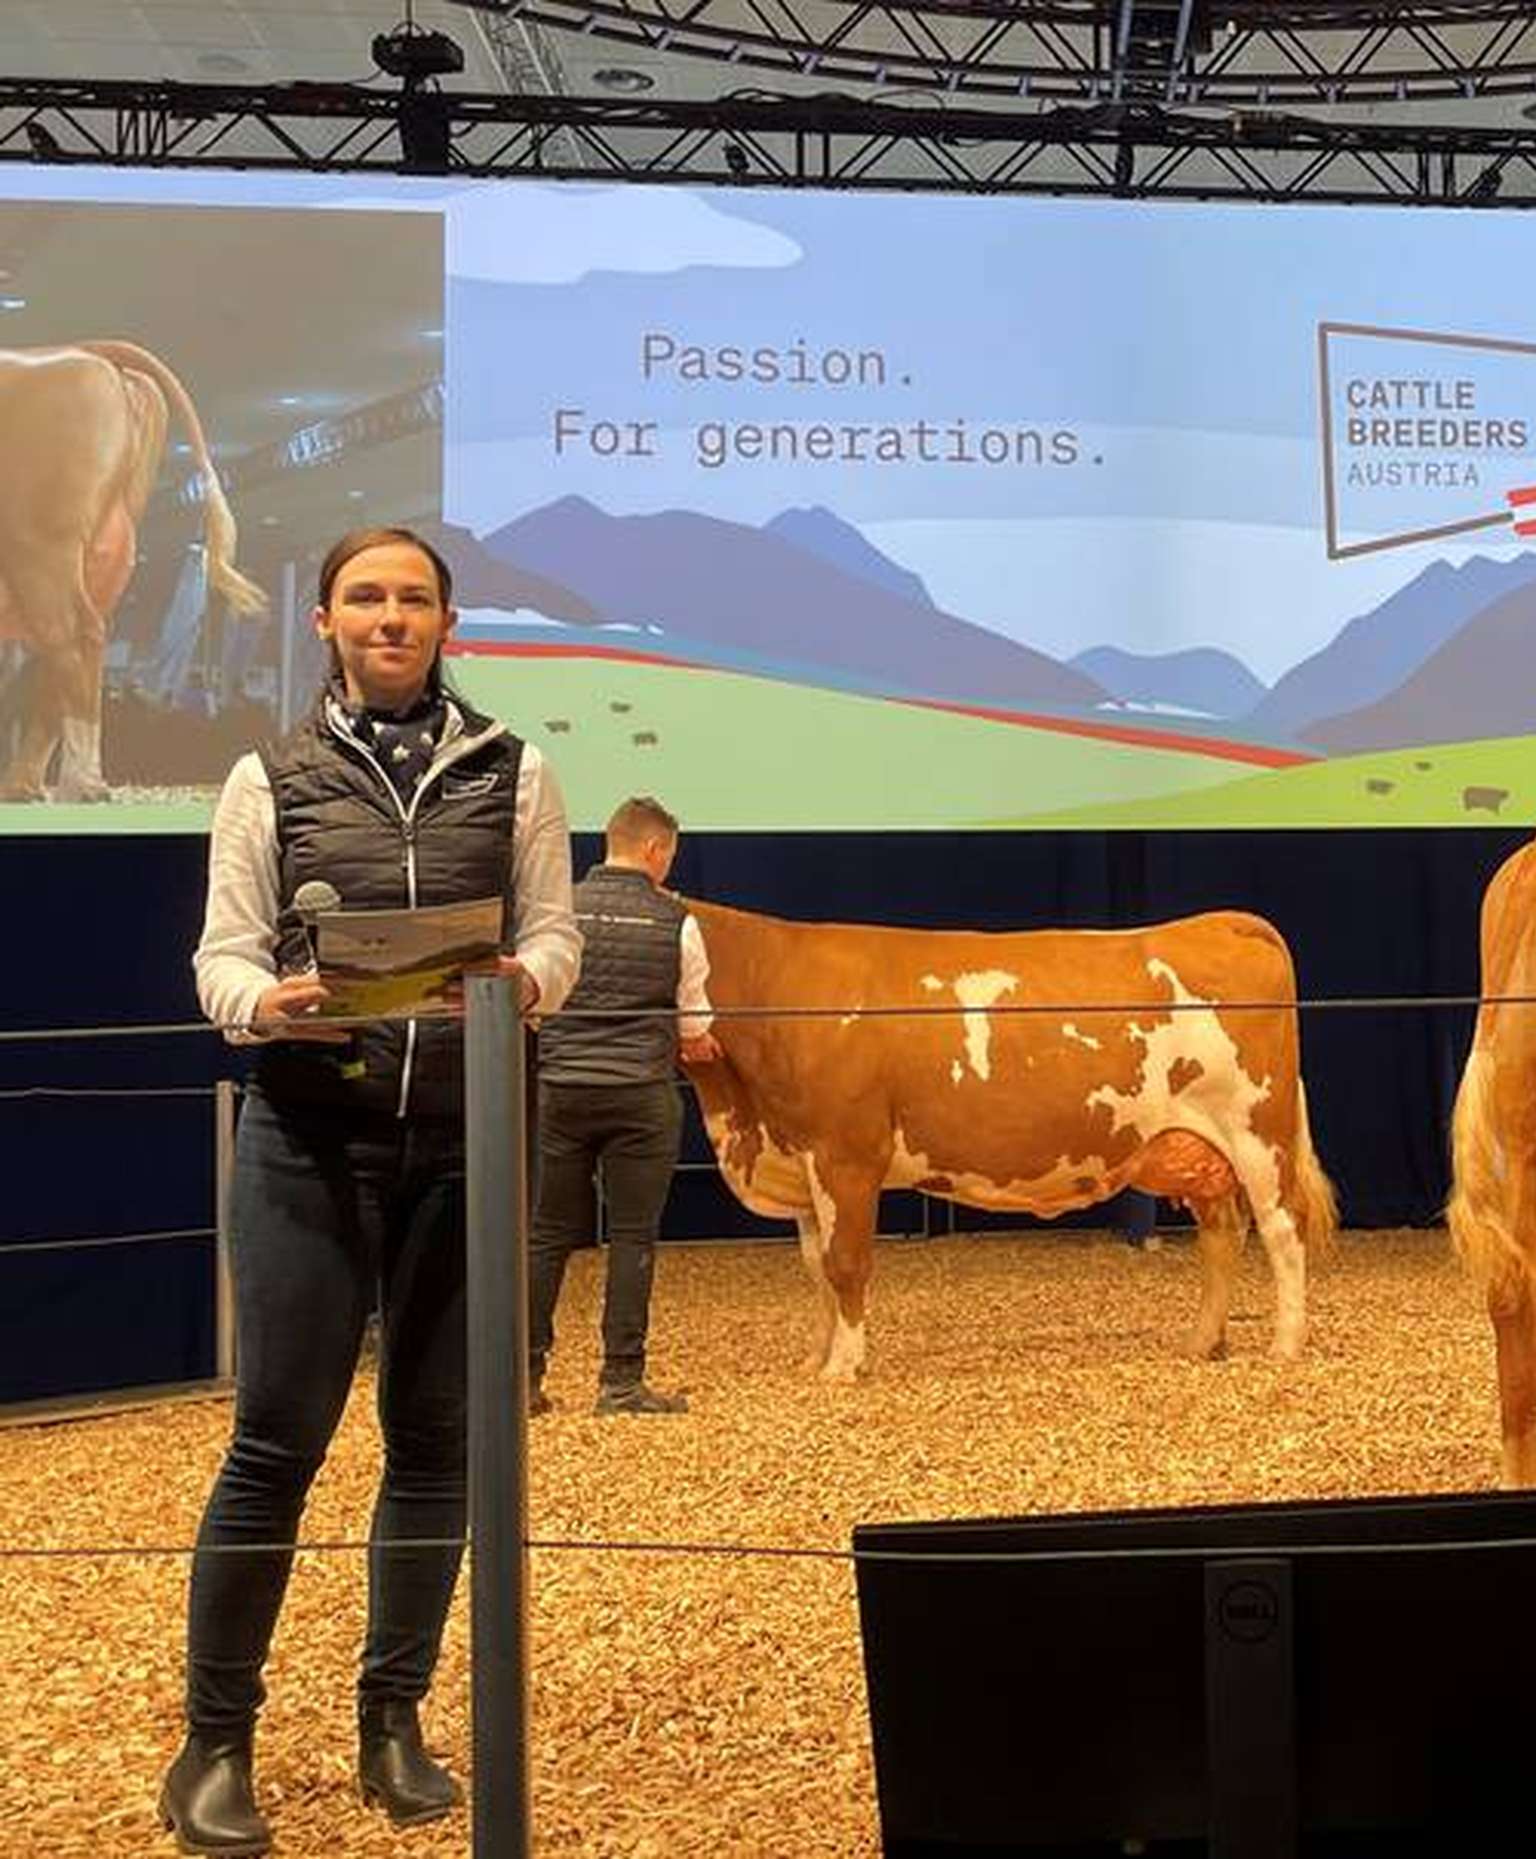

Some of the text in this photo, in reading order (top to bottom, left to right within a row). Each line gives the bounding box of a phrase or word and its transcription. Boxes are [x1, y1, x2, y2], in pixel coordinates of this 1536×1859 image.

[641, 334, 913, 386] Passion.
[1347, 381, 1475, 409] CATTLE
[553, 410, 1104, 468] For generations.
[1347, 419, 1528, 448] BREEDERS
[1347, 462, 1480, 487] AUSTRIA
